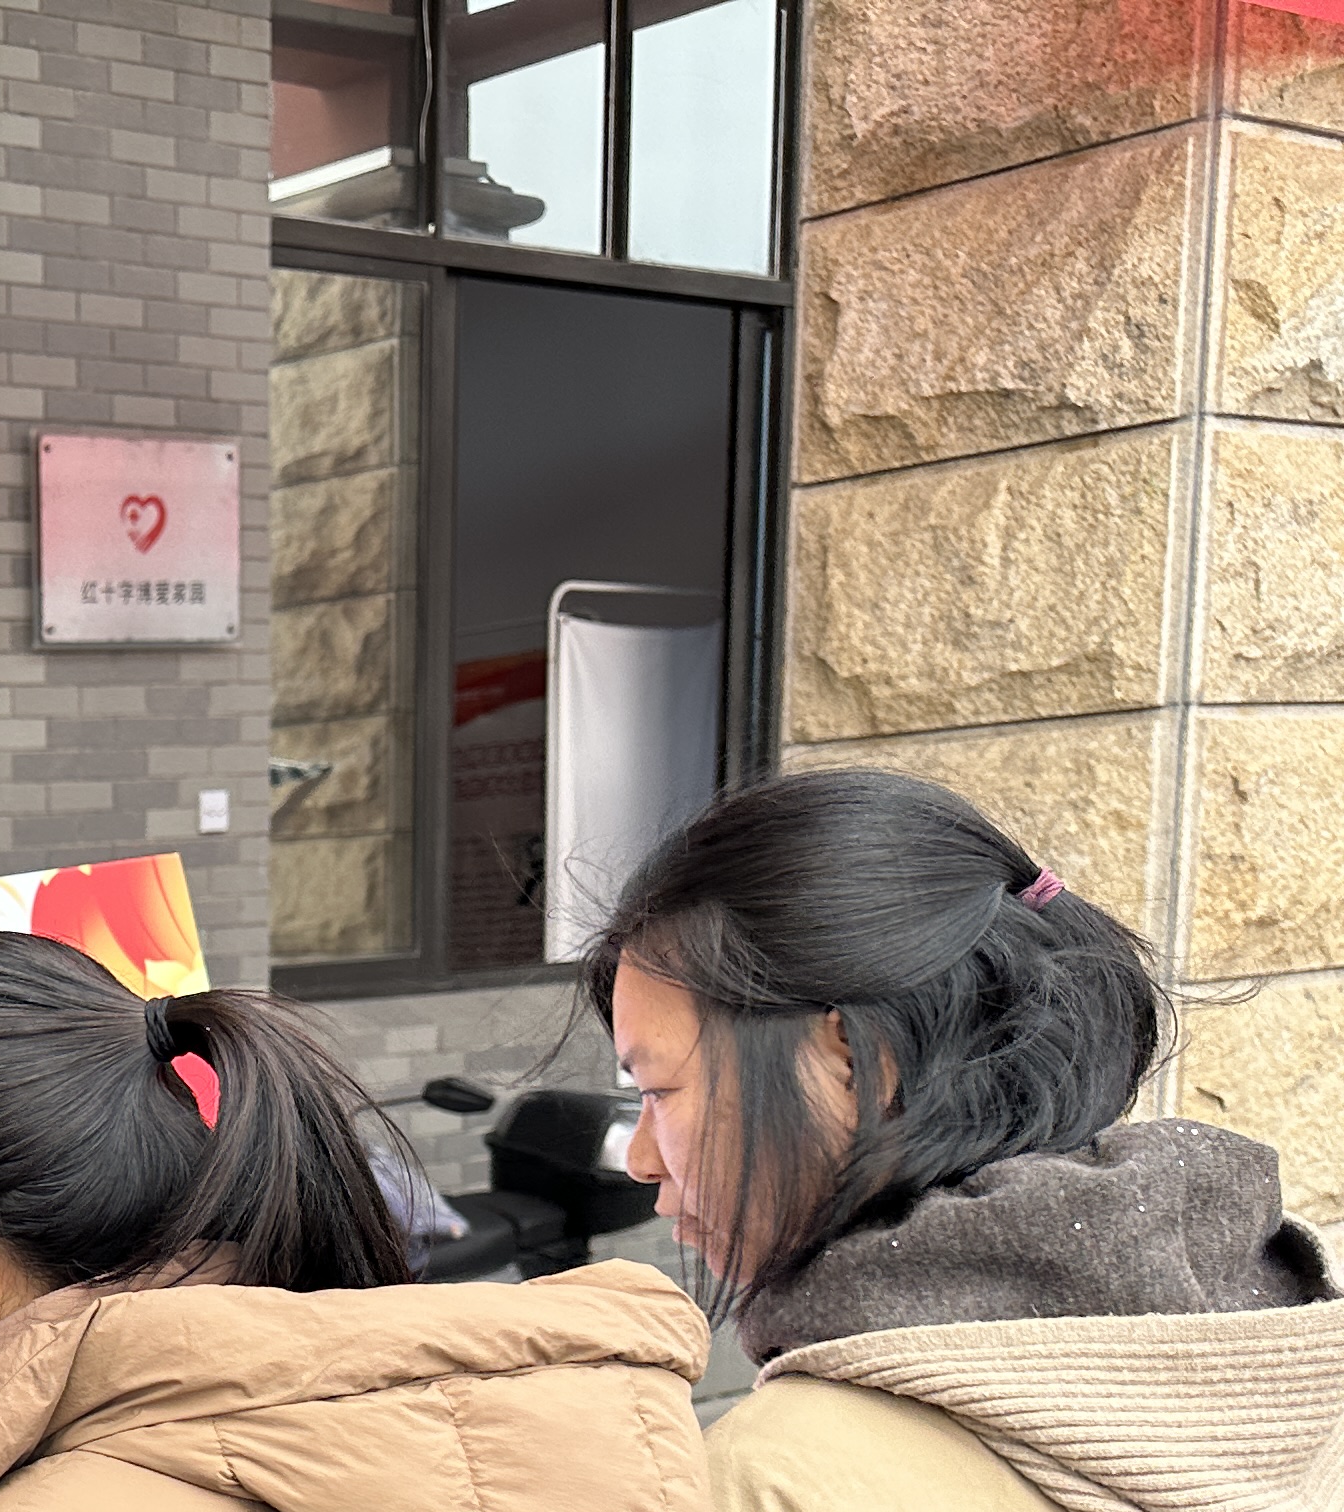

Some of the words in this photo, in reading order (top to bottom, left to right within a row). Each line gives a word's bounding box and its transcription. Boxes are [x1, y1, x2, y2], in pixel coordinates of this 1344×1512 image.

[80, 579, 207, 606] 红十字博爱家园
